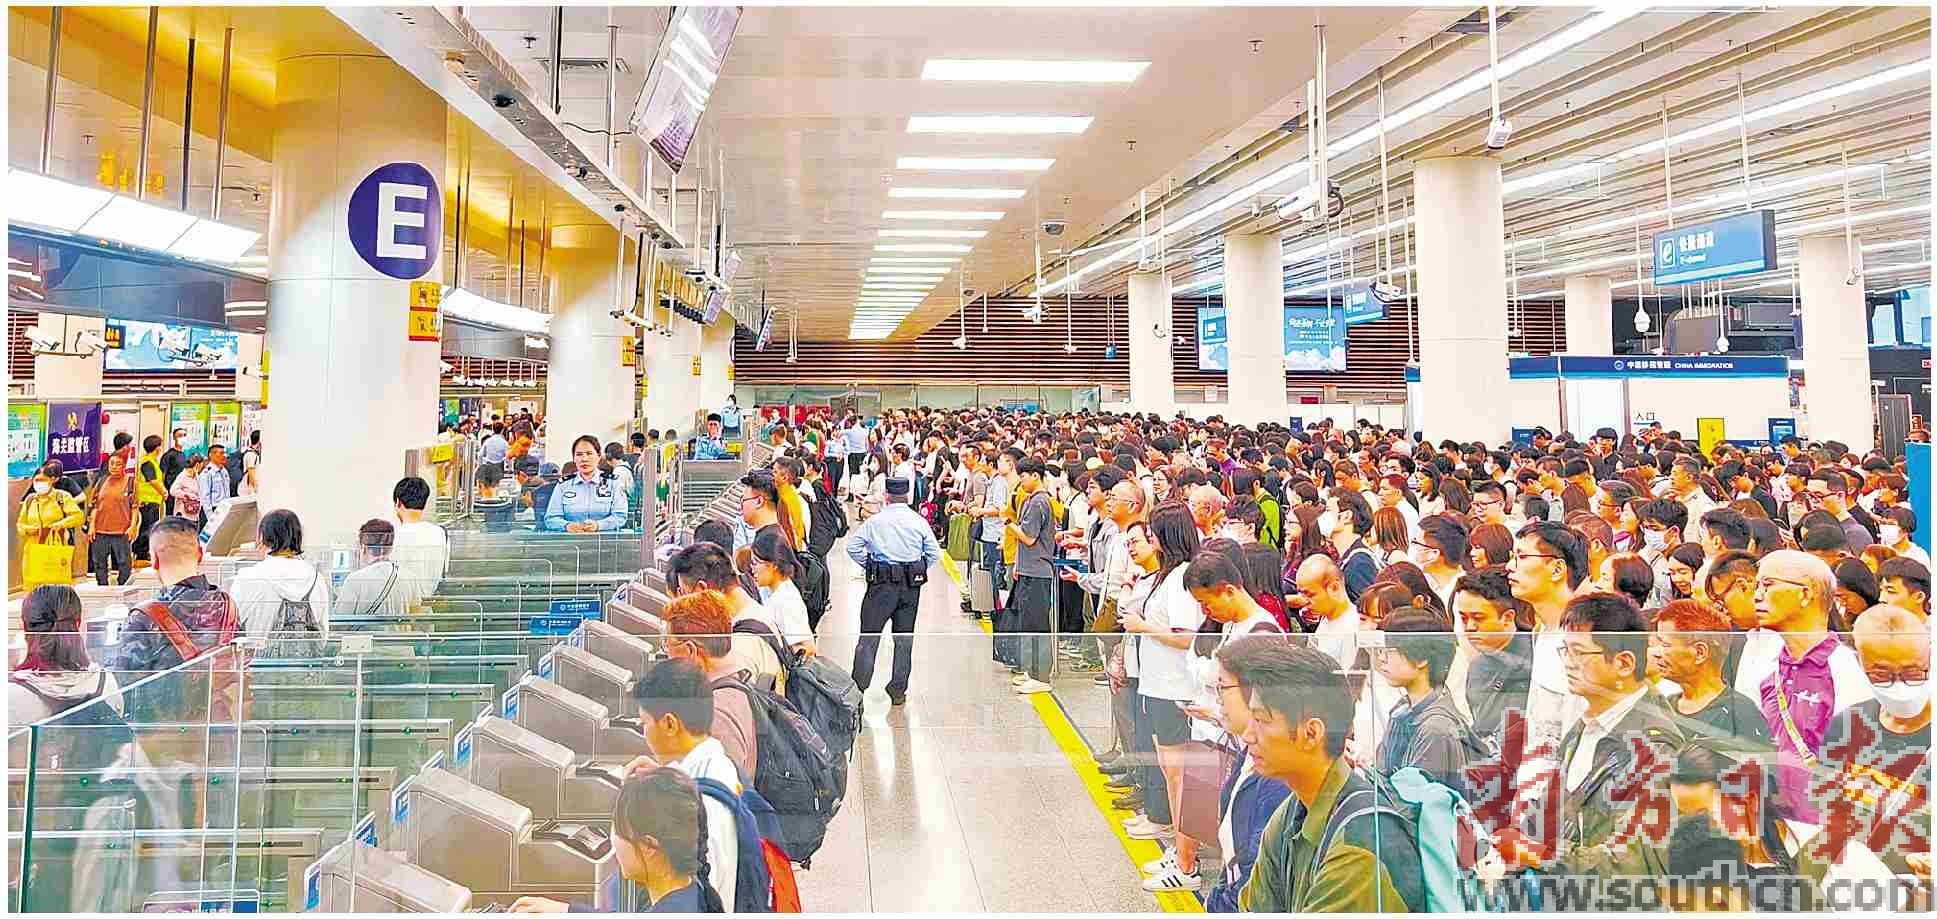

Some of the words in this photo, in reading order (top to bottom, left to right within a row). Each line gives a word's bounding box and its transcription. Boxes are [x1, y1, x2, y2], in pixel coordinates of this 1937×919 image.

[375, 182, 428, 260] E
[1636, 412, 1656, 421] 入口
[51, 436, 90, 455] 海关监管区
